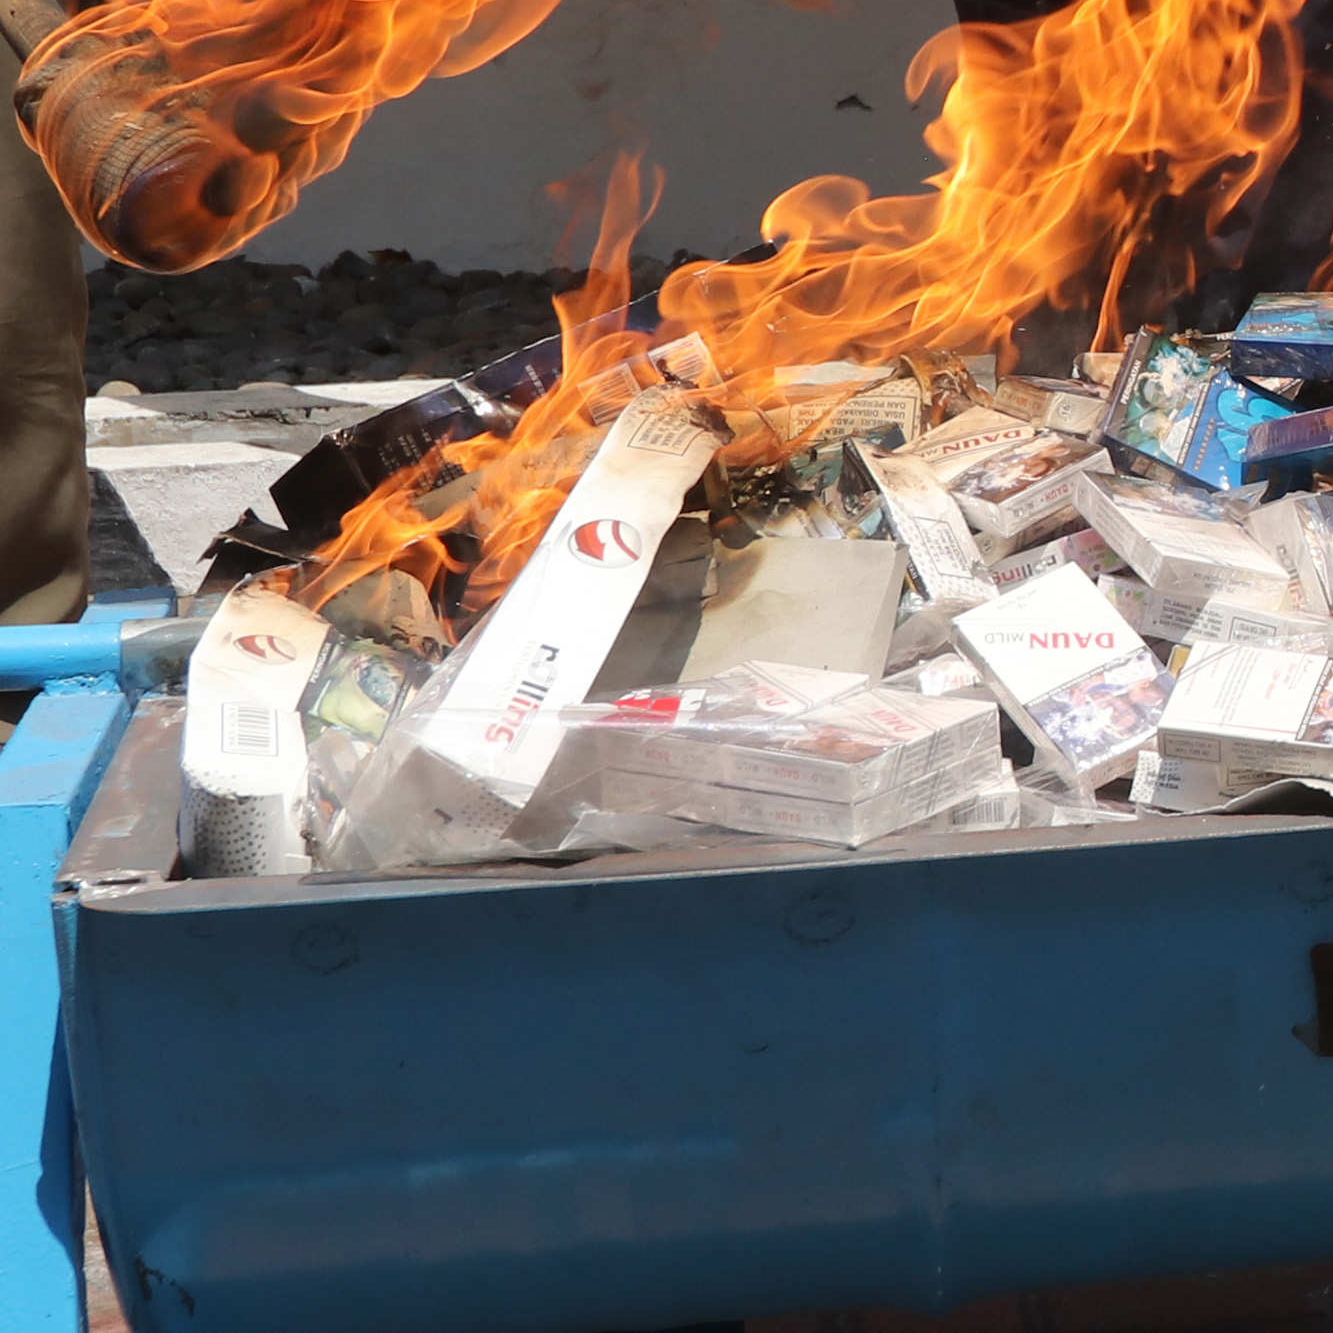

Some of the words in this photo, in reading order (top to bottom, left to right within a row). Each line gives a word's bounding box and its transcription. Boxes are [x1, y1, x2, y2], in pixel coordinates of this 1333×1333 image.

[1121, 359, 1142, 404] PERINGATAN
[942, 429, 1022, 454] DAUN
[984, 631, 1024, 645] MILD
[1029, 632, 1115, 650] DAUN
